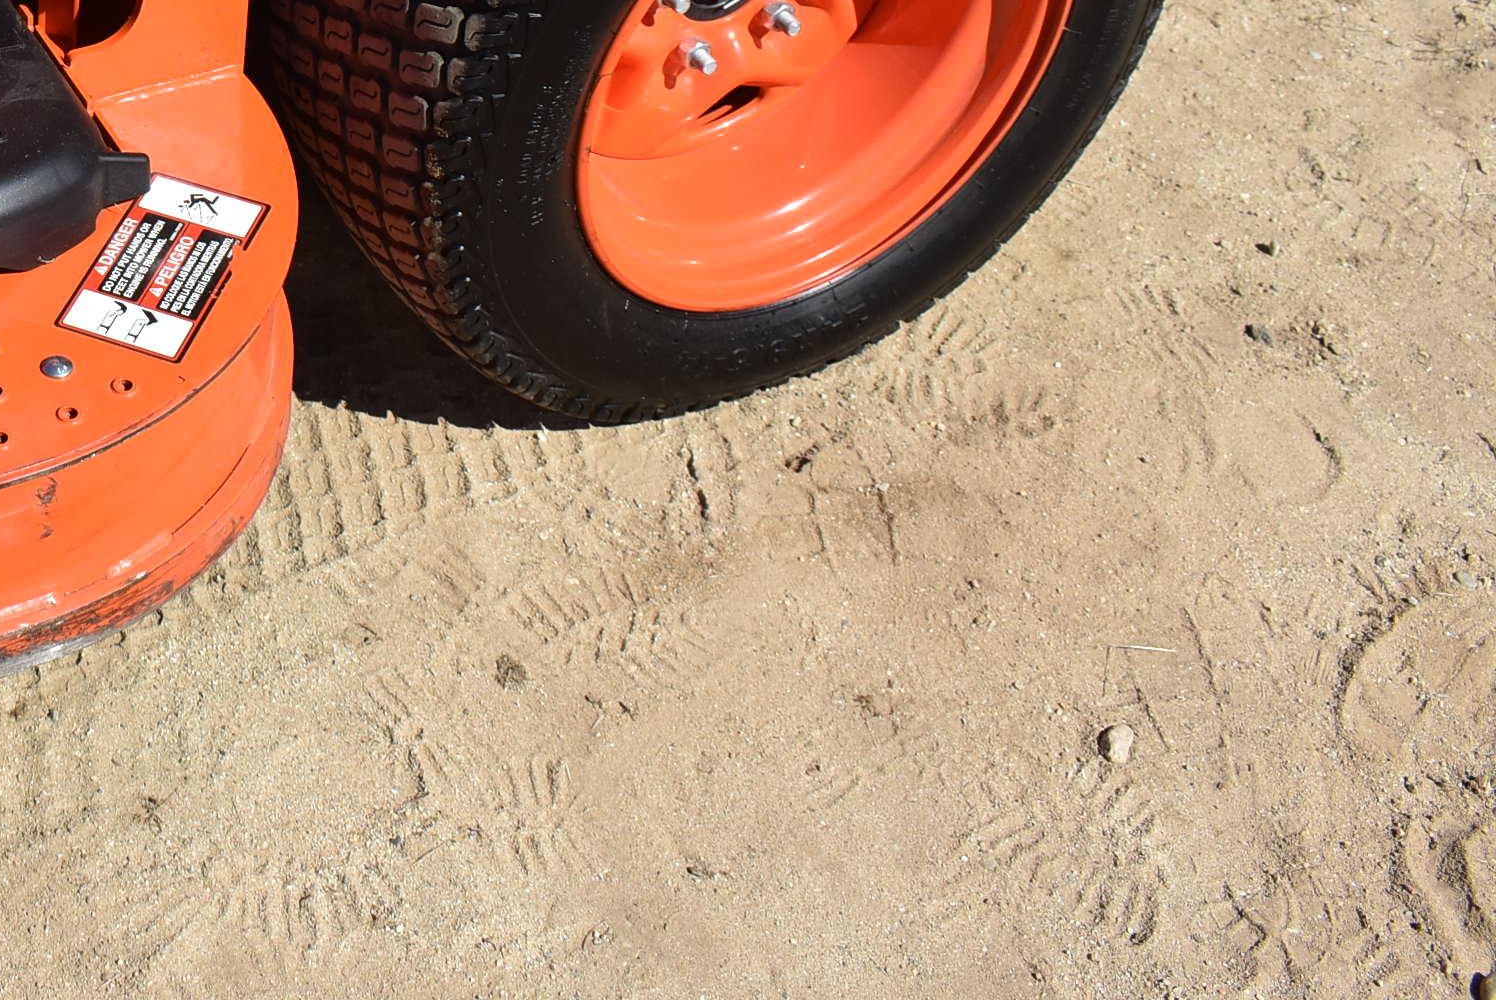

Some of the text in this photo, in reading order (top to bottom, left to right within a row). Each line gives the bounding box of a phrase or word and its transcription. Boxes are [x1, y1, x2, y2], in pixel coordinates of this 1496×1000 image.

[102, 218, 139, 269] DANGER
[195, 242, 206, 252] LOS
[102, 223, 152, 291] DO NOT PUT HANDS OR
[113, 220, 165, 295] FEET INTO MOWER WHEN
[157, 236, 194, 287] PELIGRO
[181, 255, 198, 272] MANOS
[123, 272, 144, 298] ENGINE
[138, 266, 149, 274] IS
[177, 271, 189, 281] LAS
[176, 294, 187, 302] EN
[180, 287, 191, 296] LA
[185, 292, 200, 310] MOTOR
[194, 281, 207, 294] ESTÁ
[201, 273, 211, 282] EN
[170, 301, 183, 313] PIES
